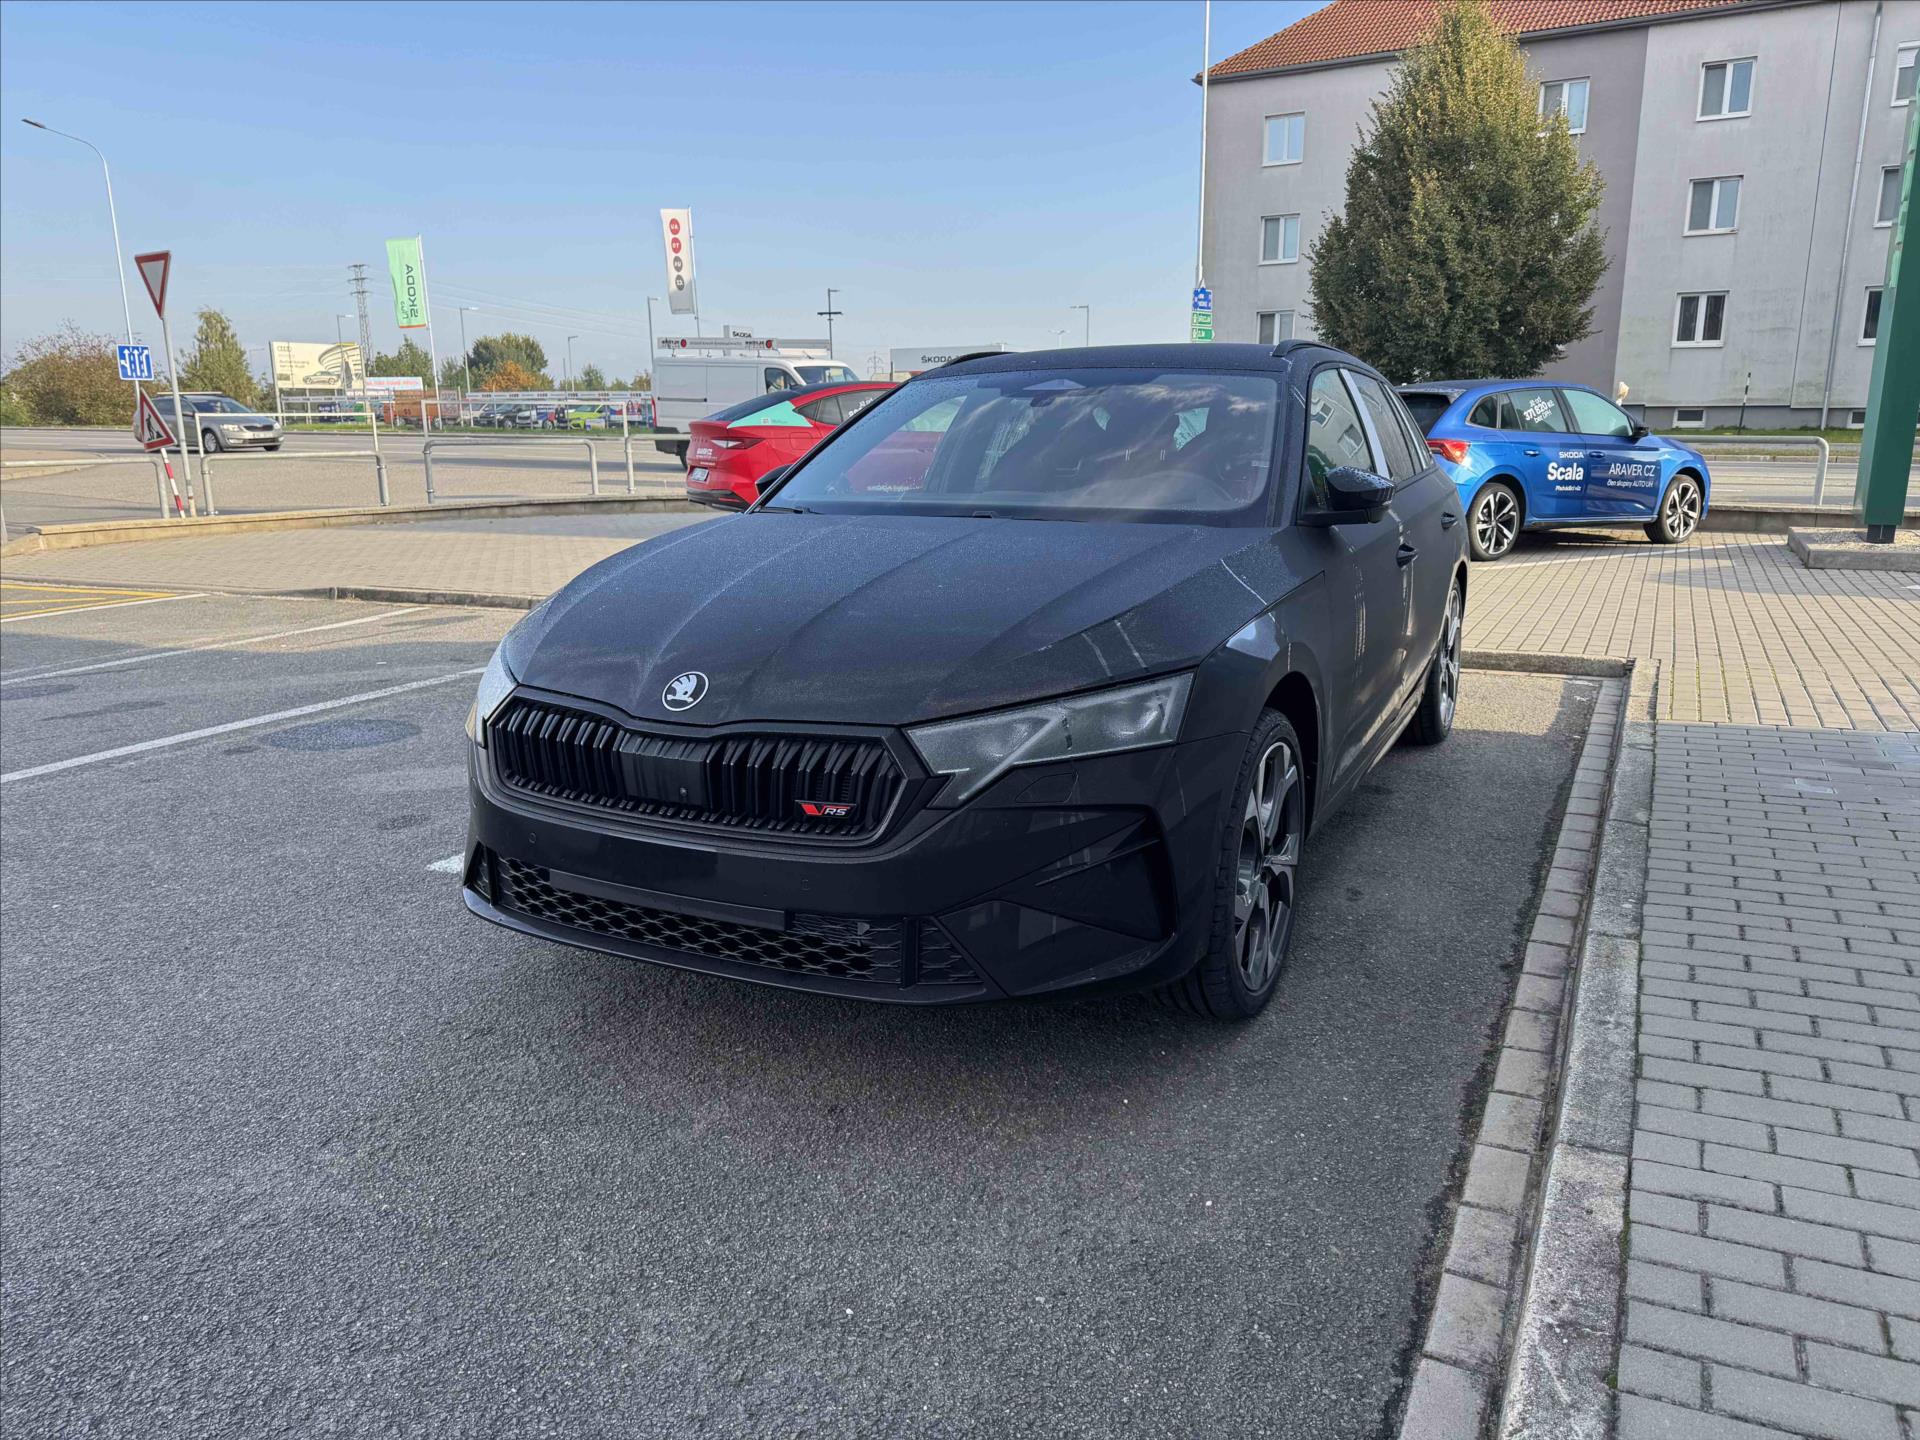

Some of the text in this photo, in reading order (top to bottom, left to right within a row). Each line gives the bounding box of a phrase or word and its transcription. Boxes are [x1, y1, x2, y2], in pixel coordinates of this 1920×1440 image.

[1547, 462, 1584, 481] Scala
[1609, 462, 1656, 476] ARAVER CZ
